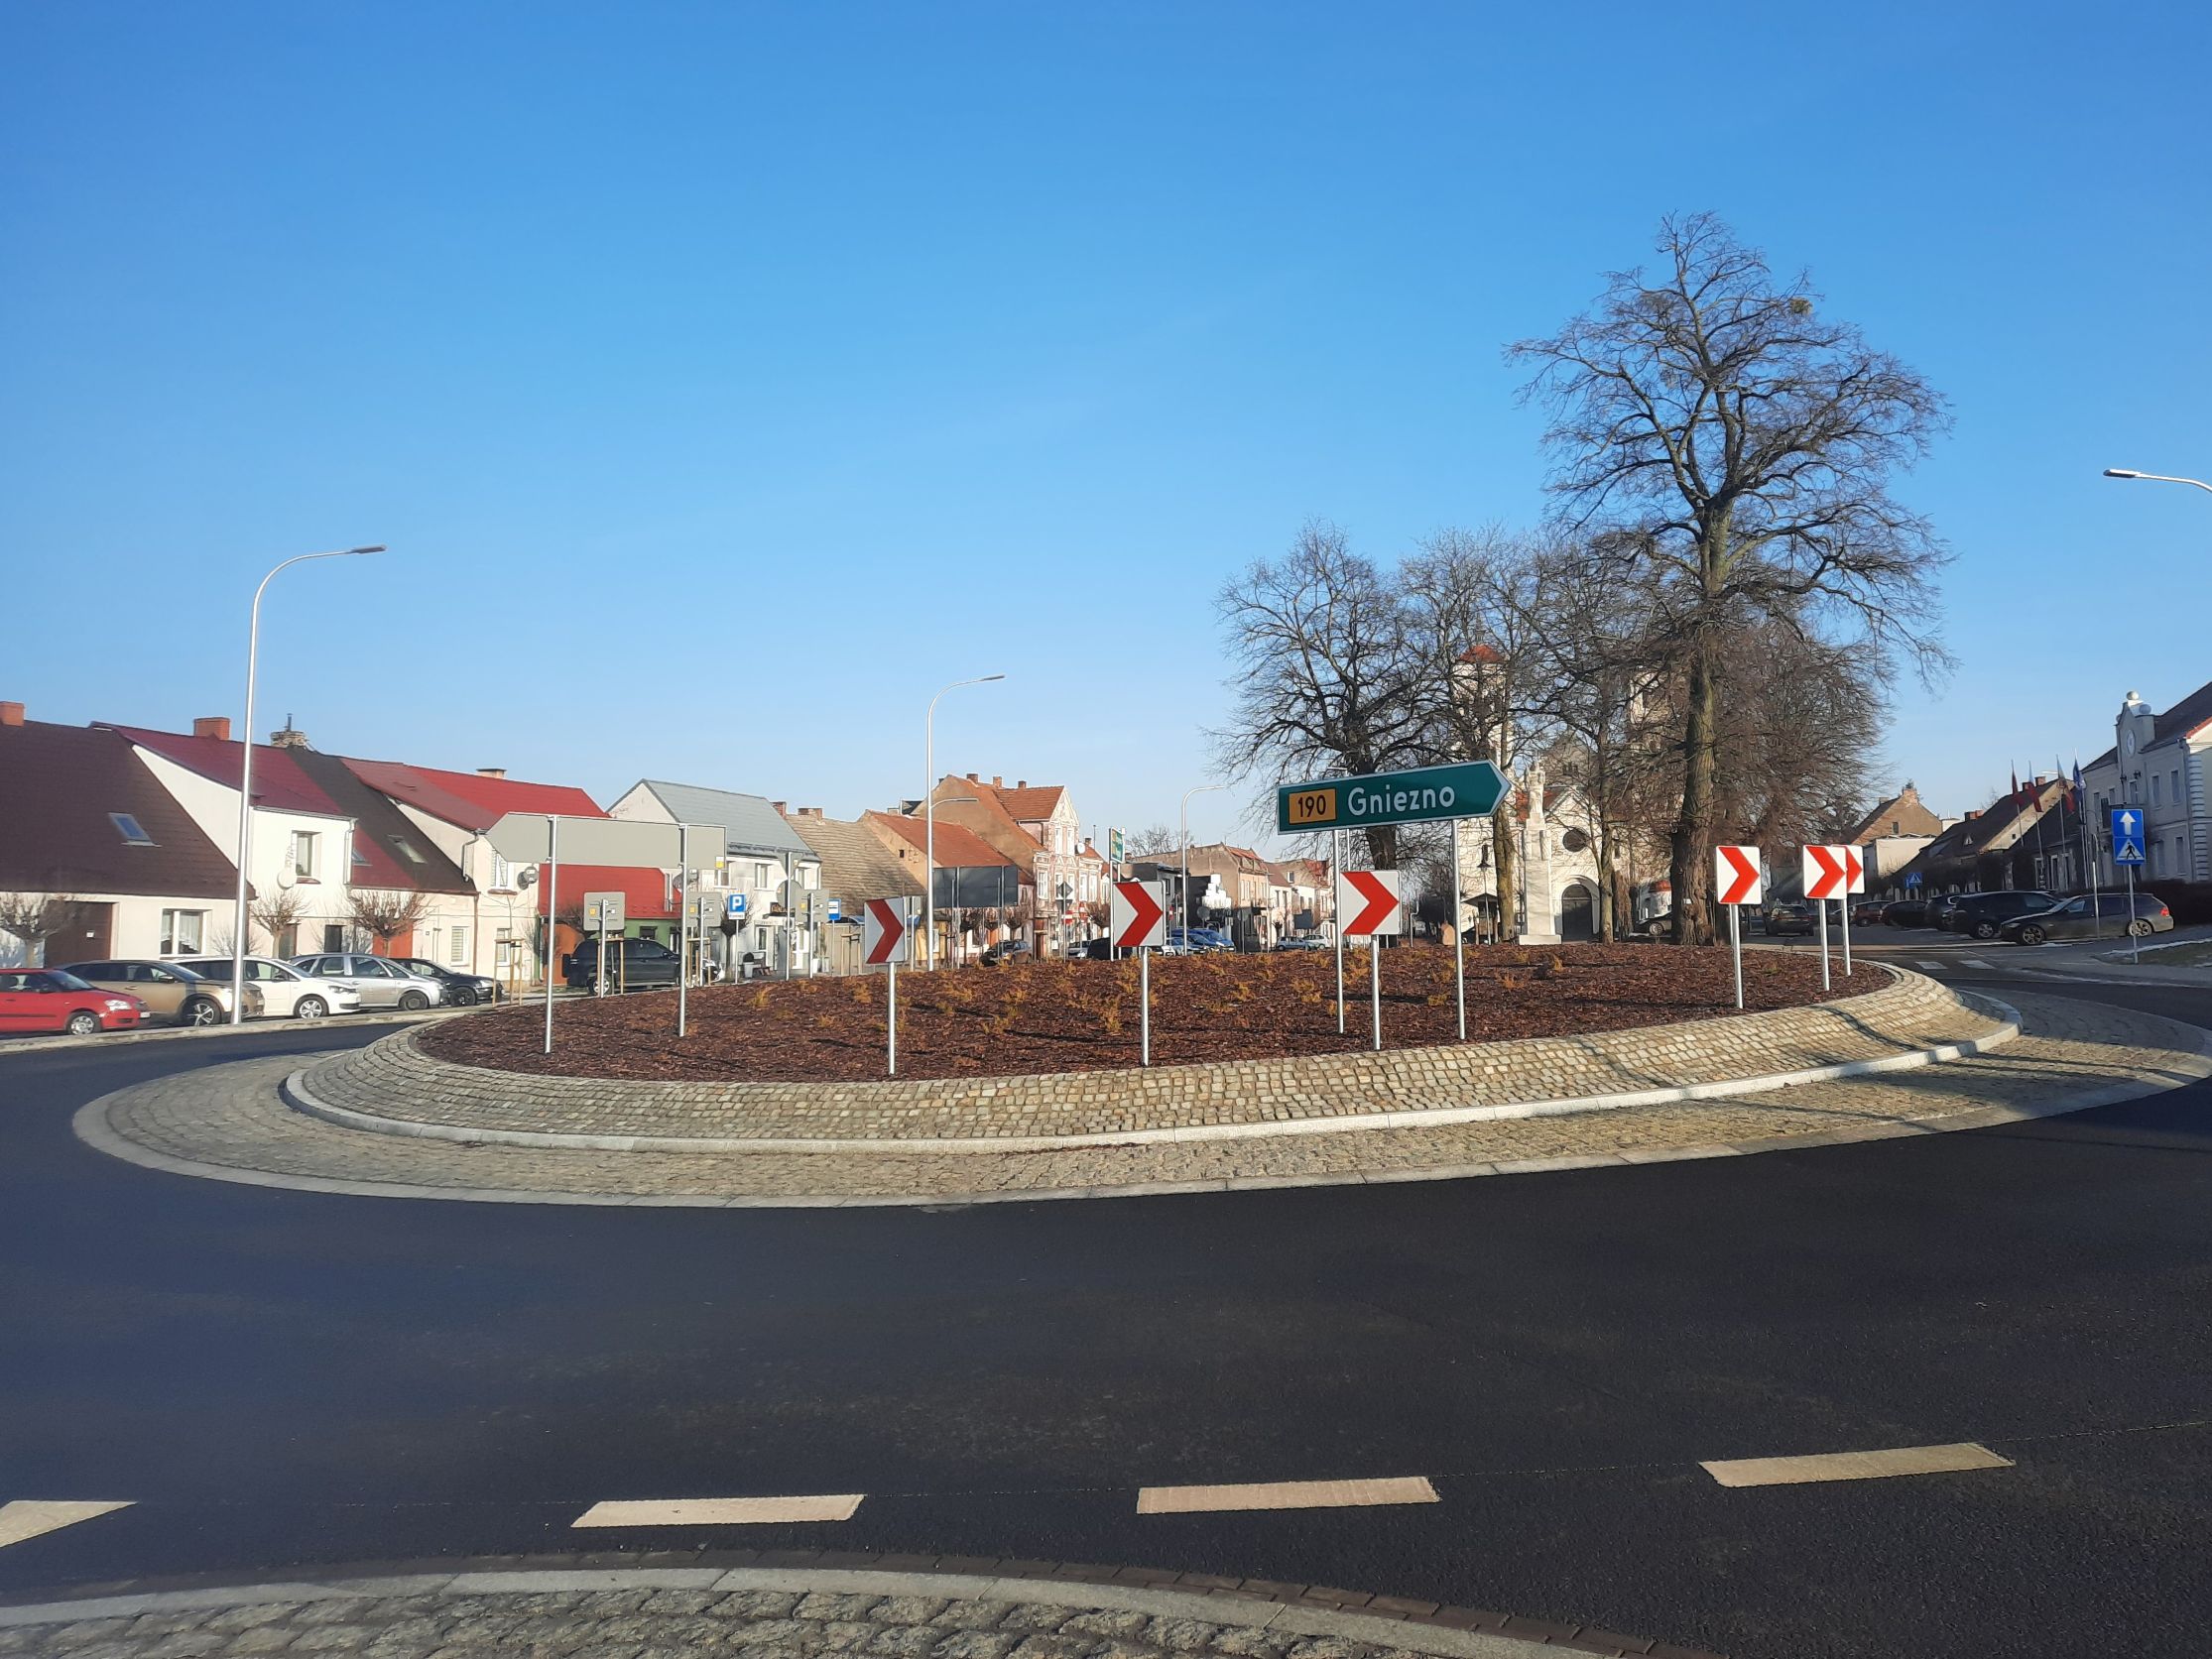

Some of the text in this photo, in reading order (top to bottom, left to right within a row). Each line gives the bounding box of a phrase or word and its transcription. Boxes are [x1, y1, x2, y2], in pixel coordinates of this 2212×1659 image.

[1297, 784, 1455, 818] 190 Gniezno
[732, 895, 742, 910] P
